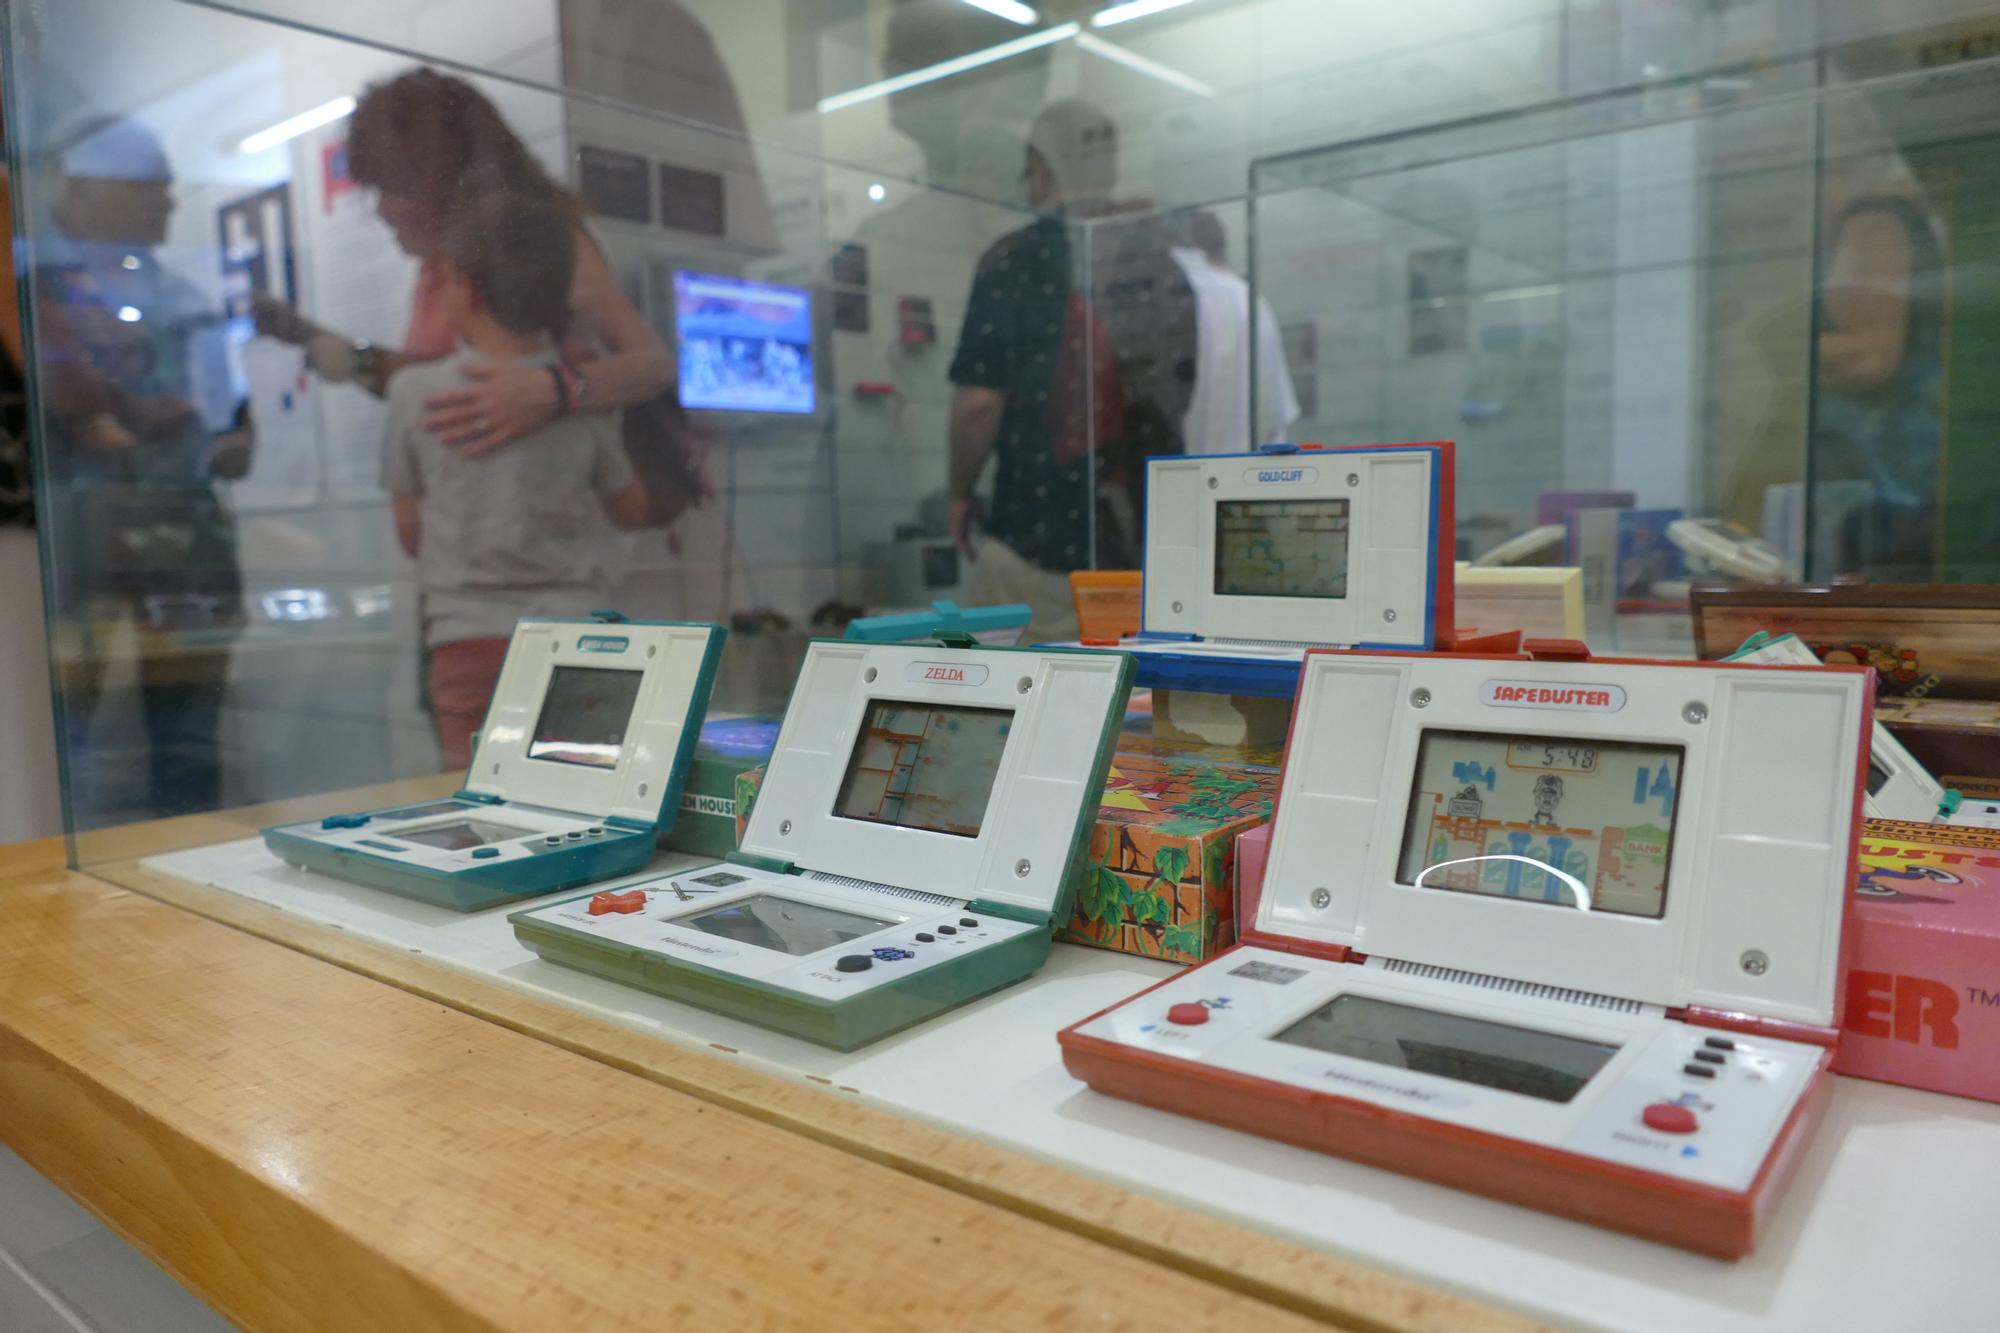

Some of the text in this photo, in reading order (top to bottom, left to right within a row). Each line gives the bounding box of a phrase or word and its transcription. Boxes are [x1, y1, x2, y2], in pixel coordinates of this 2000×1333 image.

[924, 667, 964, 681] ZELDA
[1492, 686, 1610, 706] SAFEBUSTER
[699, 797, 736, 815] HOUSE
[1627, 842, 1664, 854] BANK
